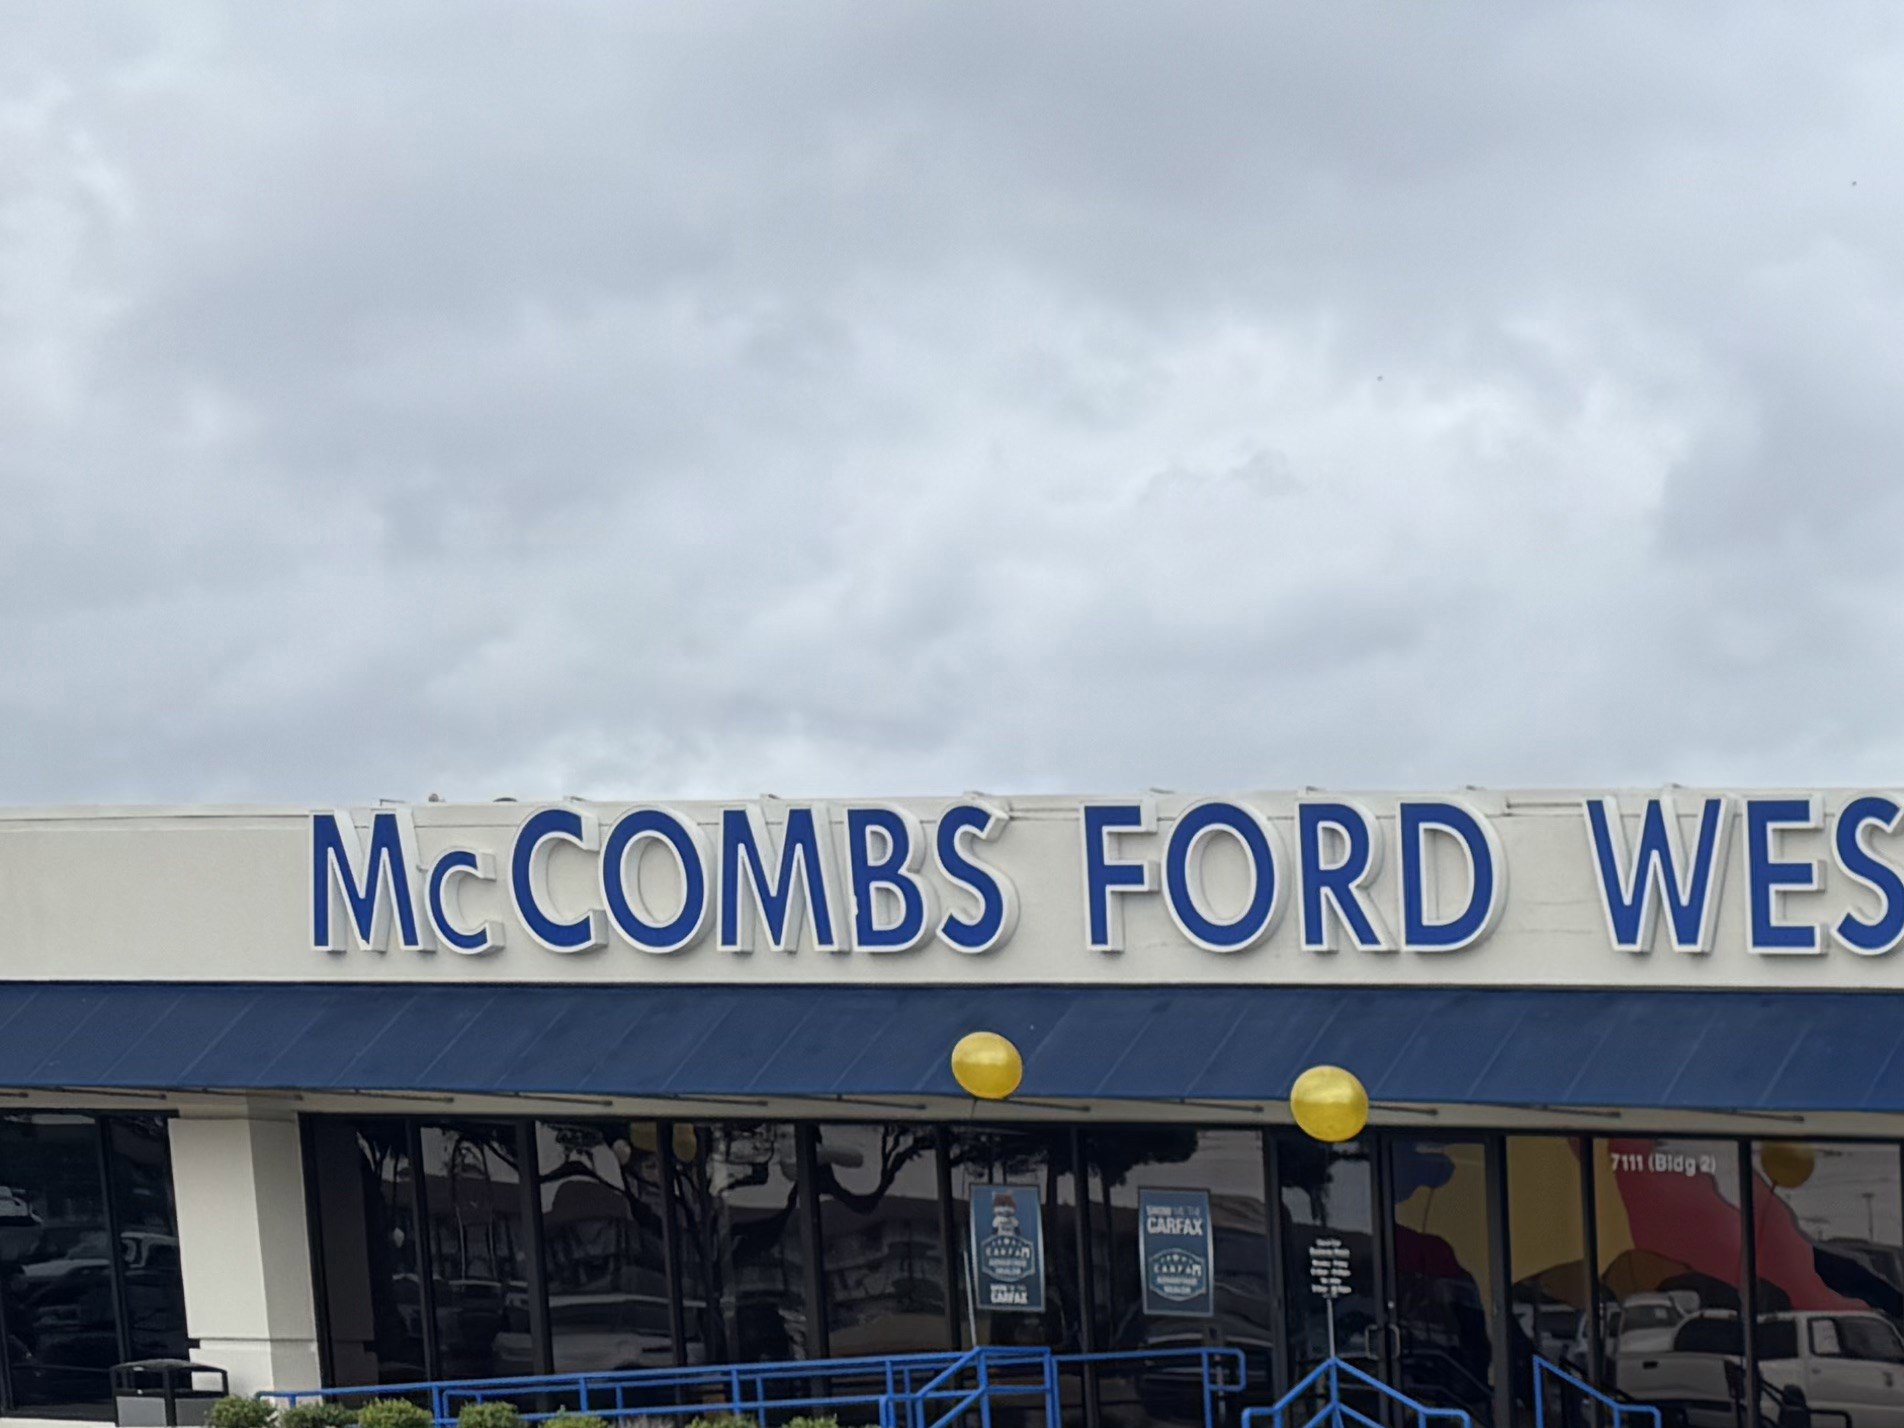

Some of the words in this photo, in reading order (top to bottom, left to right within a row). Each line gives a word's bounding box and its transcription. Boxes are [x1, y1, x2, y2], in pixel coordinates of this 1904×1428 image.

[1083, 800, 1497, 950] FORD
[1611, 1153, 1643, 1172] 7111
[1649, 1153, 1696, 1177] (Bldg
[1700, 1154, 1717, 1174] 2)
[1146, 1217, 1203, 1236] CARFAX
